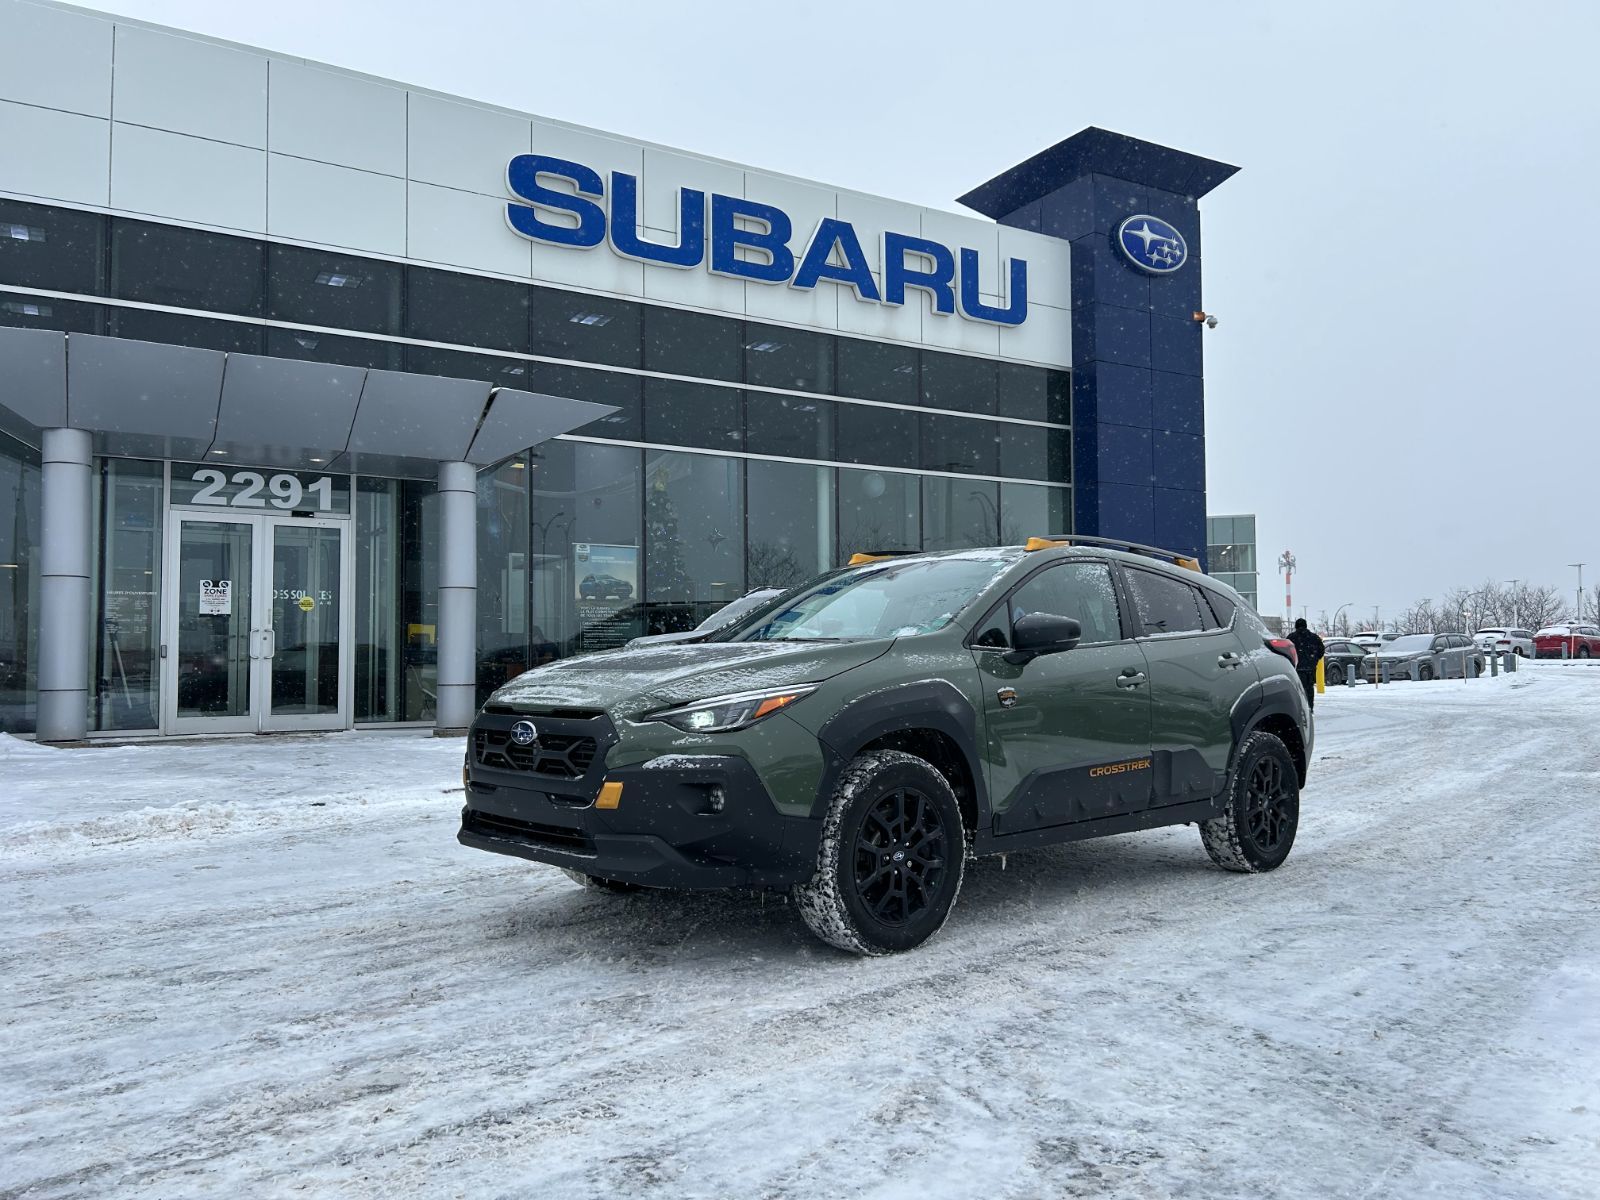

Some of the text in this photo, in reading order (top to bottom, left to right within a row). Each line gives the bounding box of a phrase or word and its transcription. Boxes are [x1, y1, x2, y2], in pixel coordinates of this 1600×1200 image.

[504, 153, 1028, 327] SUBARU
[190, 469, 332, 511] 2291
[1089, 759, 1151, 777] CROSSTREK
